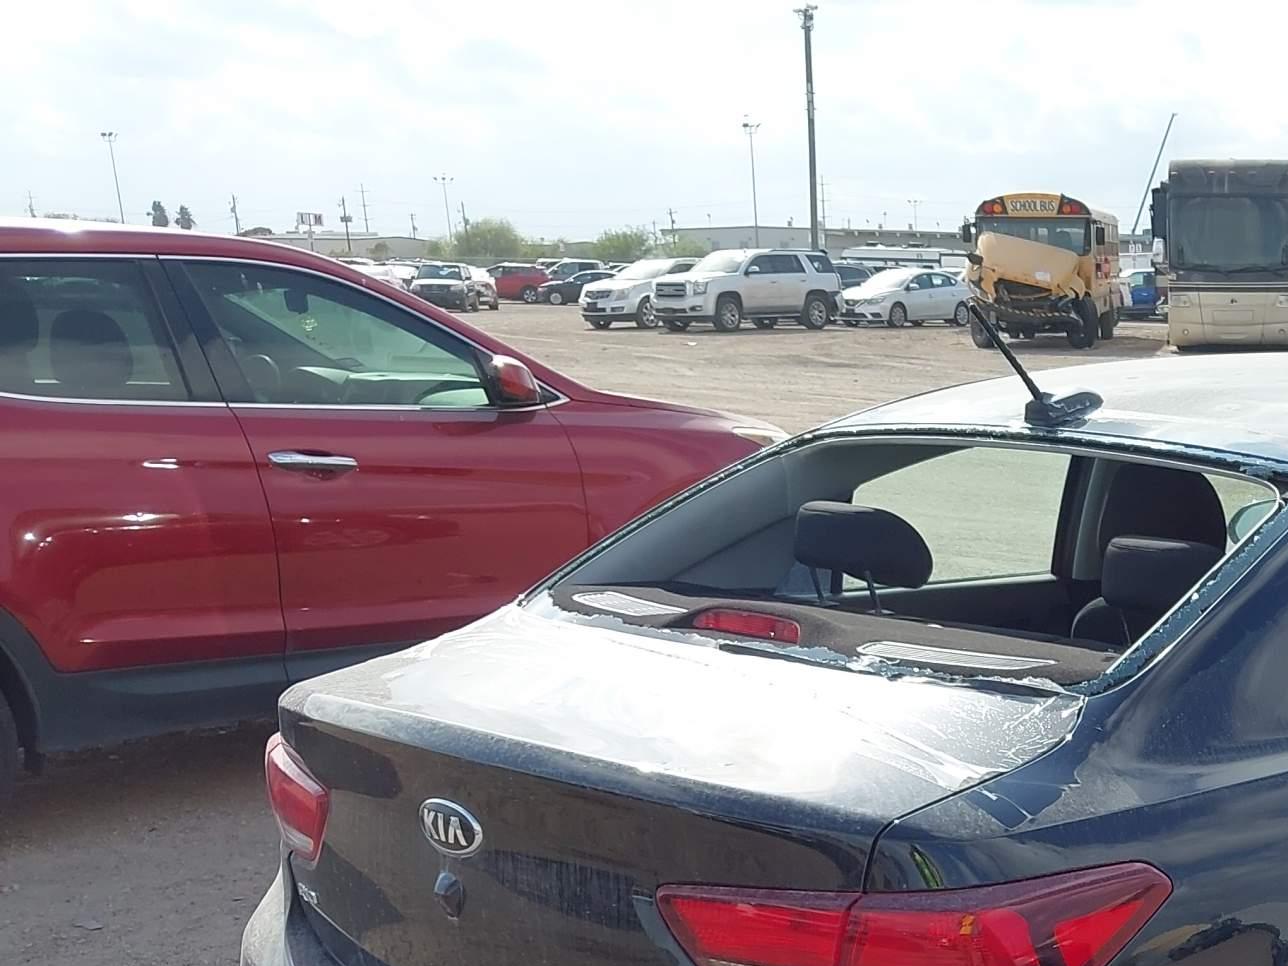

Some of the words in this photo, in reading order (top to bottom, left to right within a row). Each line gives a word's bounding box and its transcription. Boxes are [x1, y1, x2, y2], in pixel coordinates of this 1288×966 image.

[1010, 199, 1039, 212] SCHOOL
[1039, 199, 1056, 212] BUS
[423, 807, 468, 846] KIA
